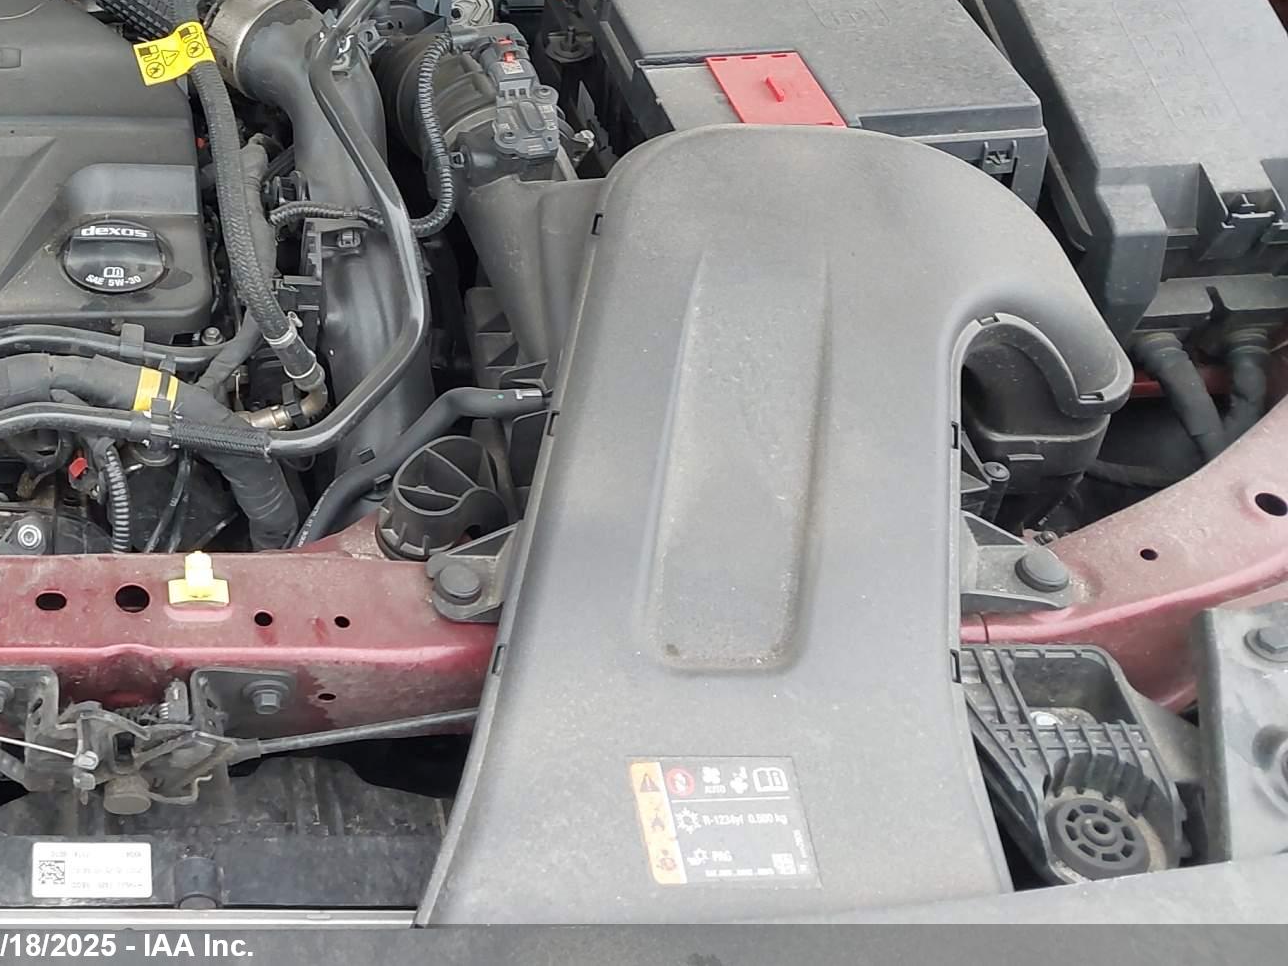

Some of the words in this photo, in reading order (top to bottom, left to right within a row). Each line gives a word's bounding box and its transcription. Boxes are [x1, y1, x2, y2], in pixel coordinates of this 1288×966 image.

[80, 225, 151, 238] dexos
[85, 274, 105, 286] SAE
[107, 275, 142, 287] 5W-30
